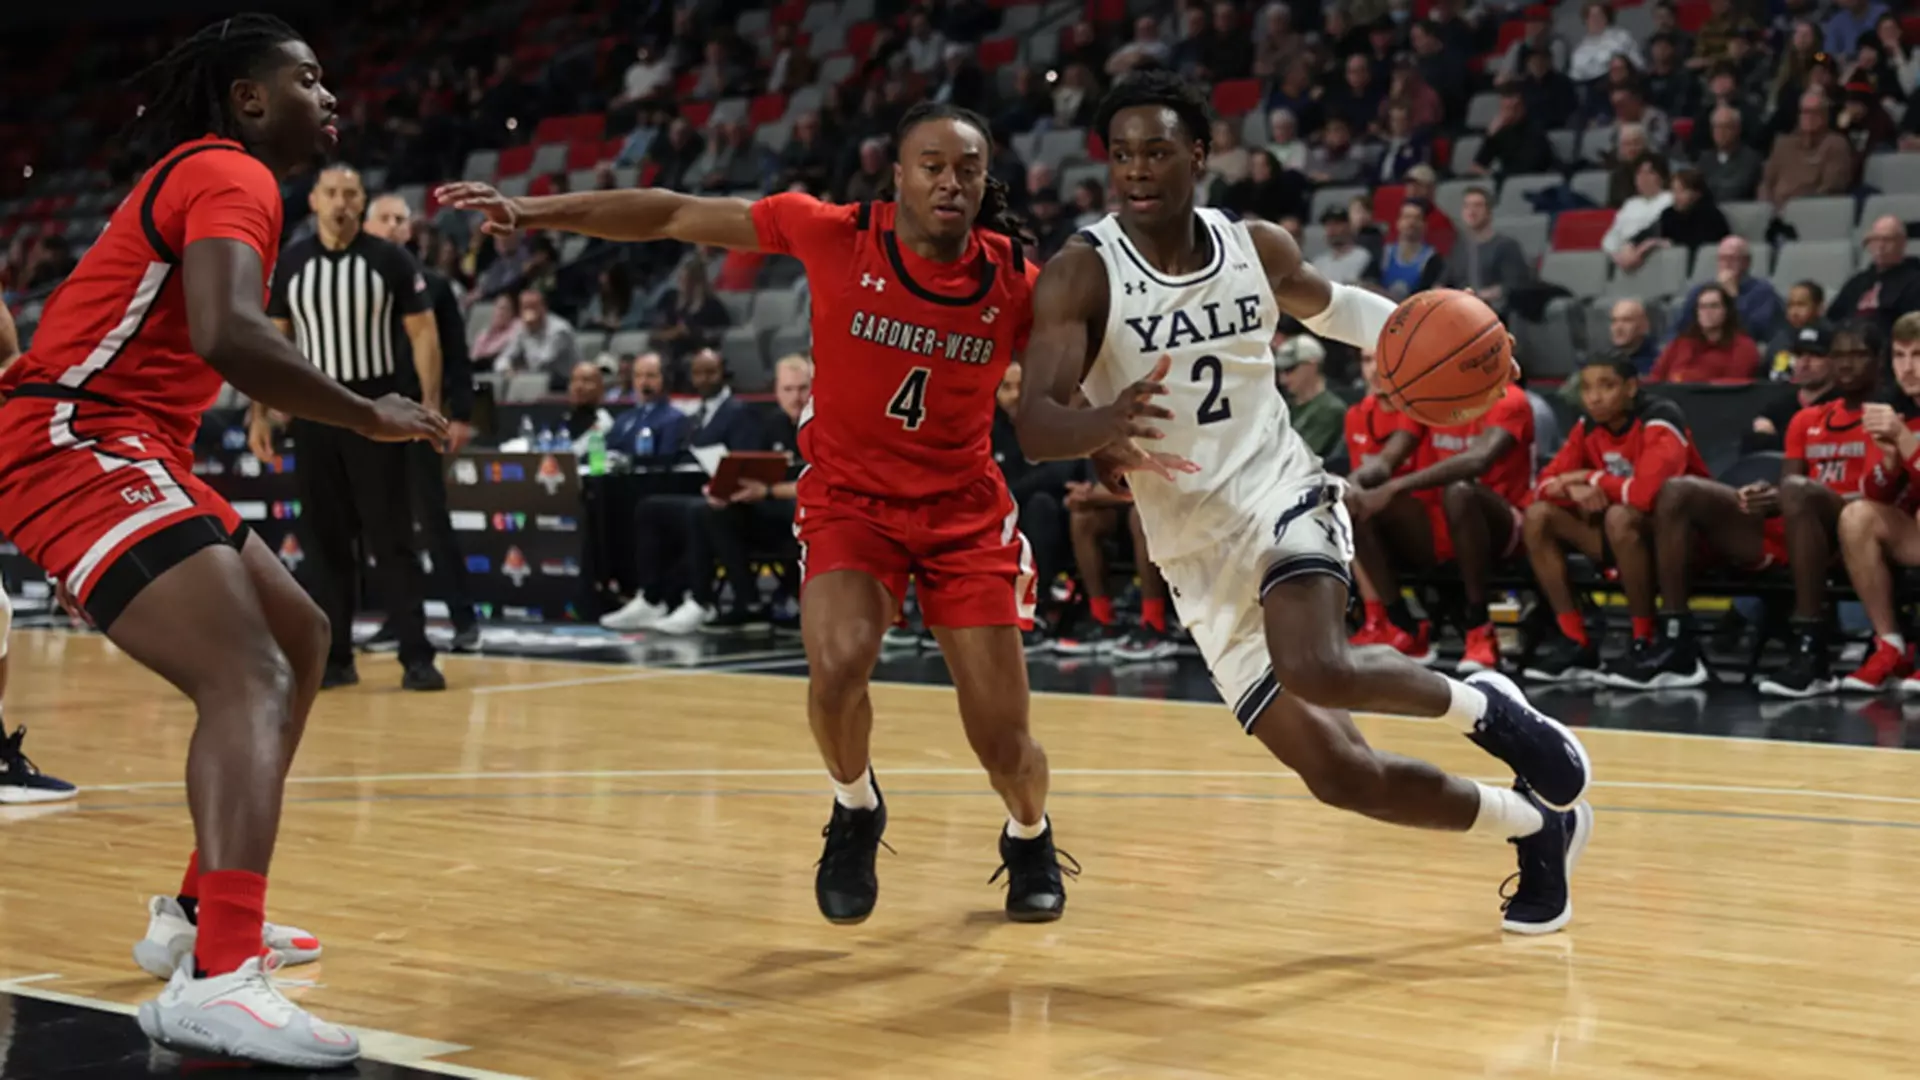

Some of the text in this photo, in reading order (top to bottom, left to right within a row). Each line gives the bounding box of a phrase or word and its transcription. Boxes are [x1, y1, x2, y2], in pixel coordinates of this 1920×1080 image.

[850, 311, 994, 364] GARDNER-WEBB
[1125, 294, 1262, 353] YALE
[885, 366, 932, 431] 4
[1191, 355, 1231, 425] 2
[121, 486, 156, 505] GW
